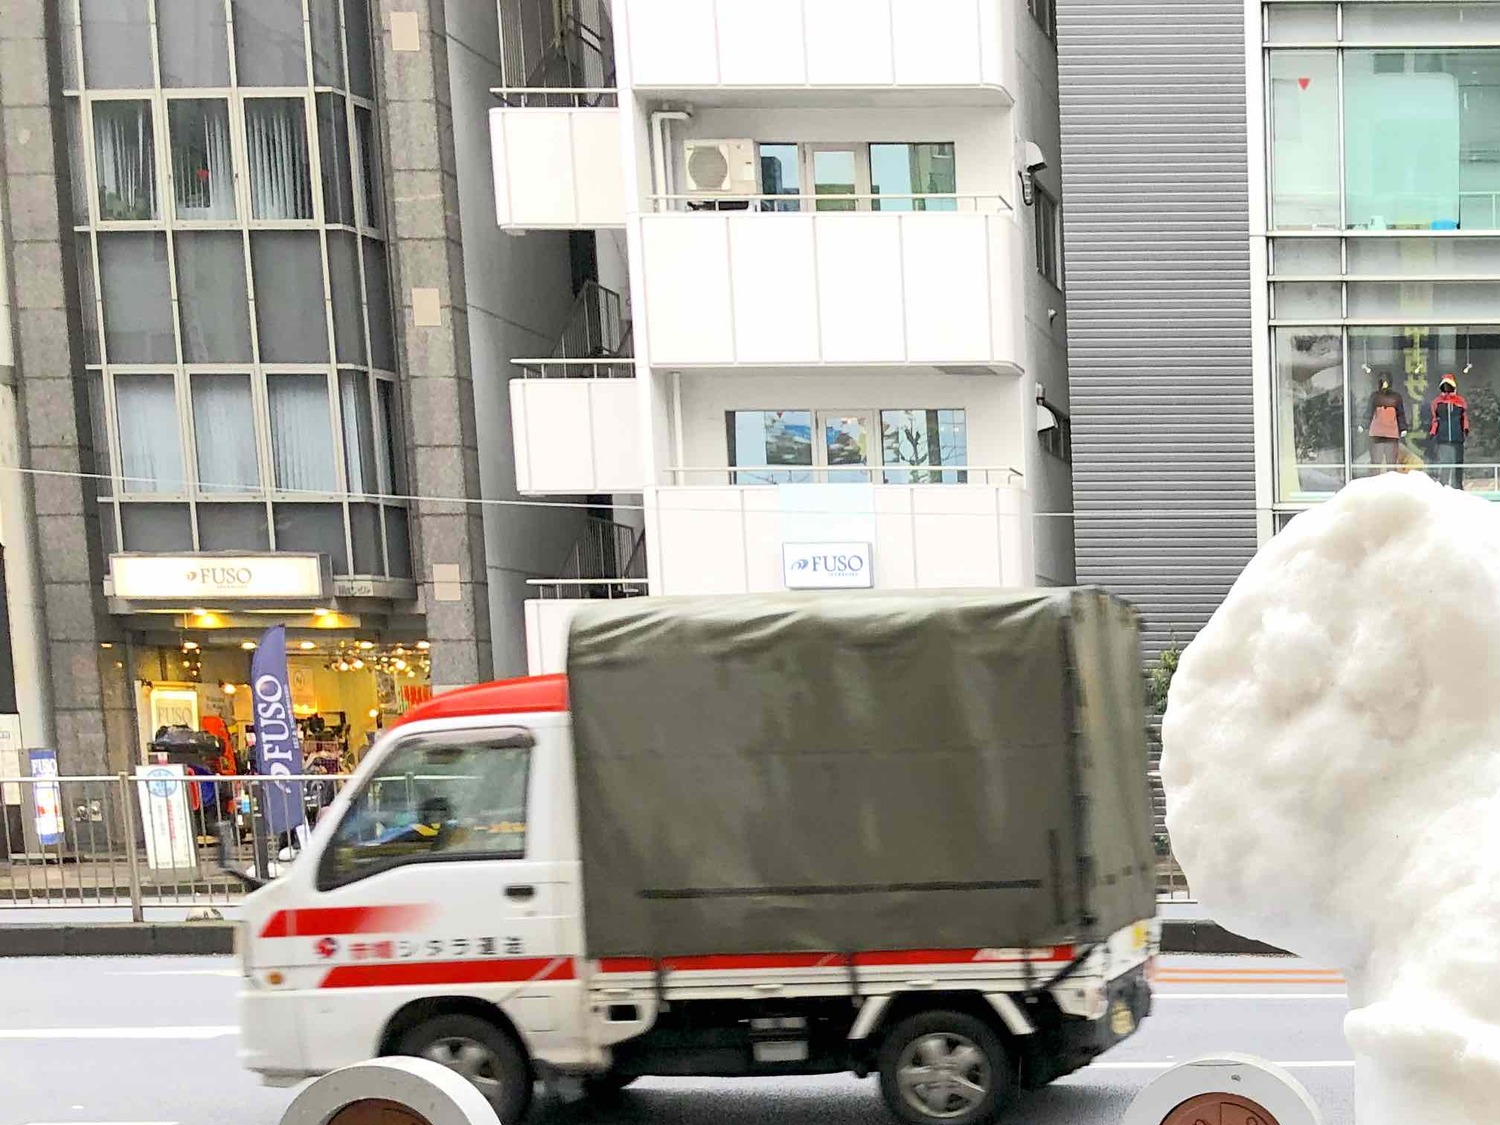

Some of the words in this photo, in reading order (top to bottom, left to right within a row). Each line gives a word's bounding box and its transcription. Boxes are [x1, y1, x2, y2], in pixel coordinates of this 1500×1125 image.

[812, 554, 864, 572] FUSO
[200, 567, 253, 584] FUSO
[254, 674, 293, 762] FUSO
